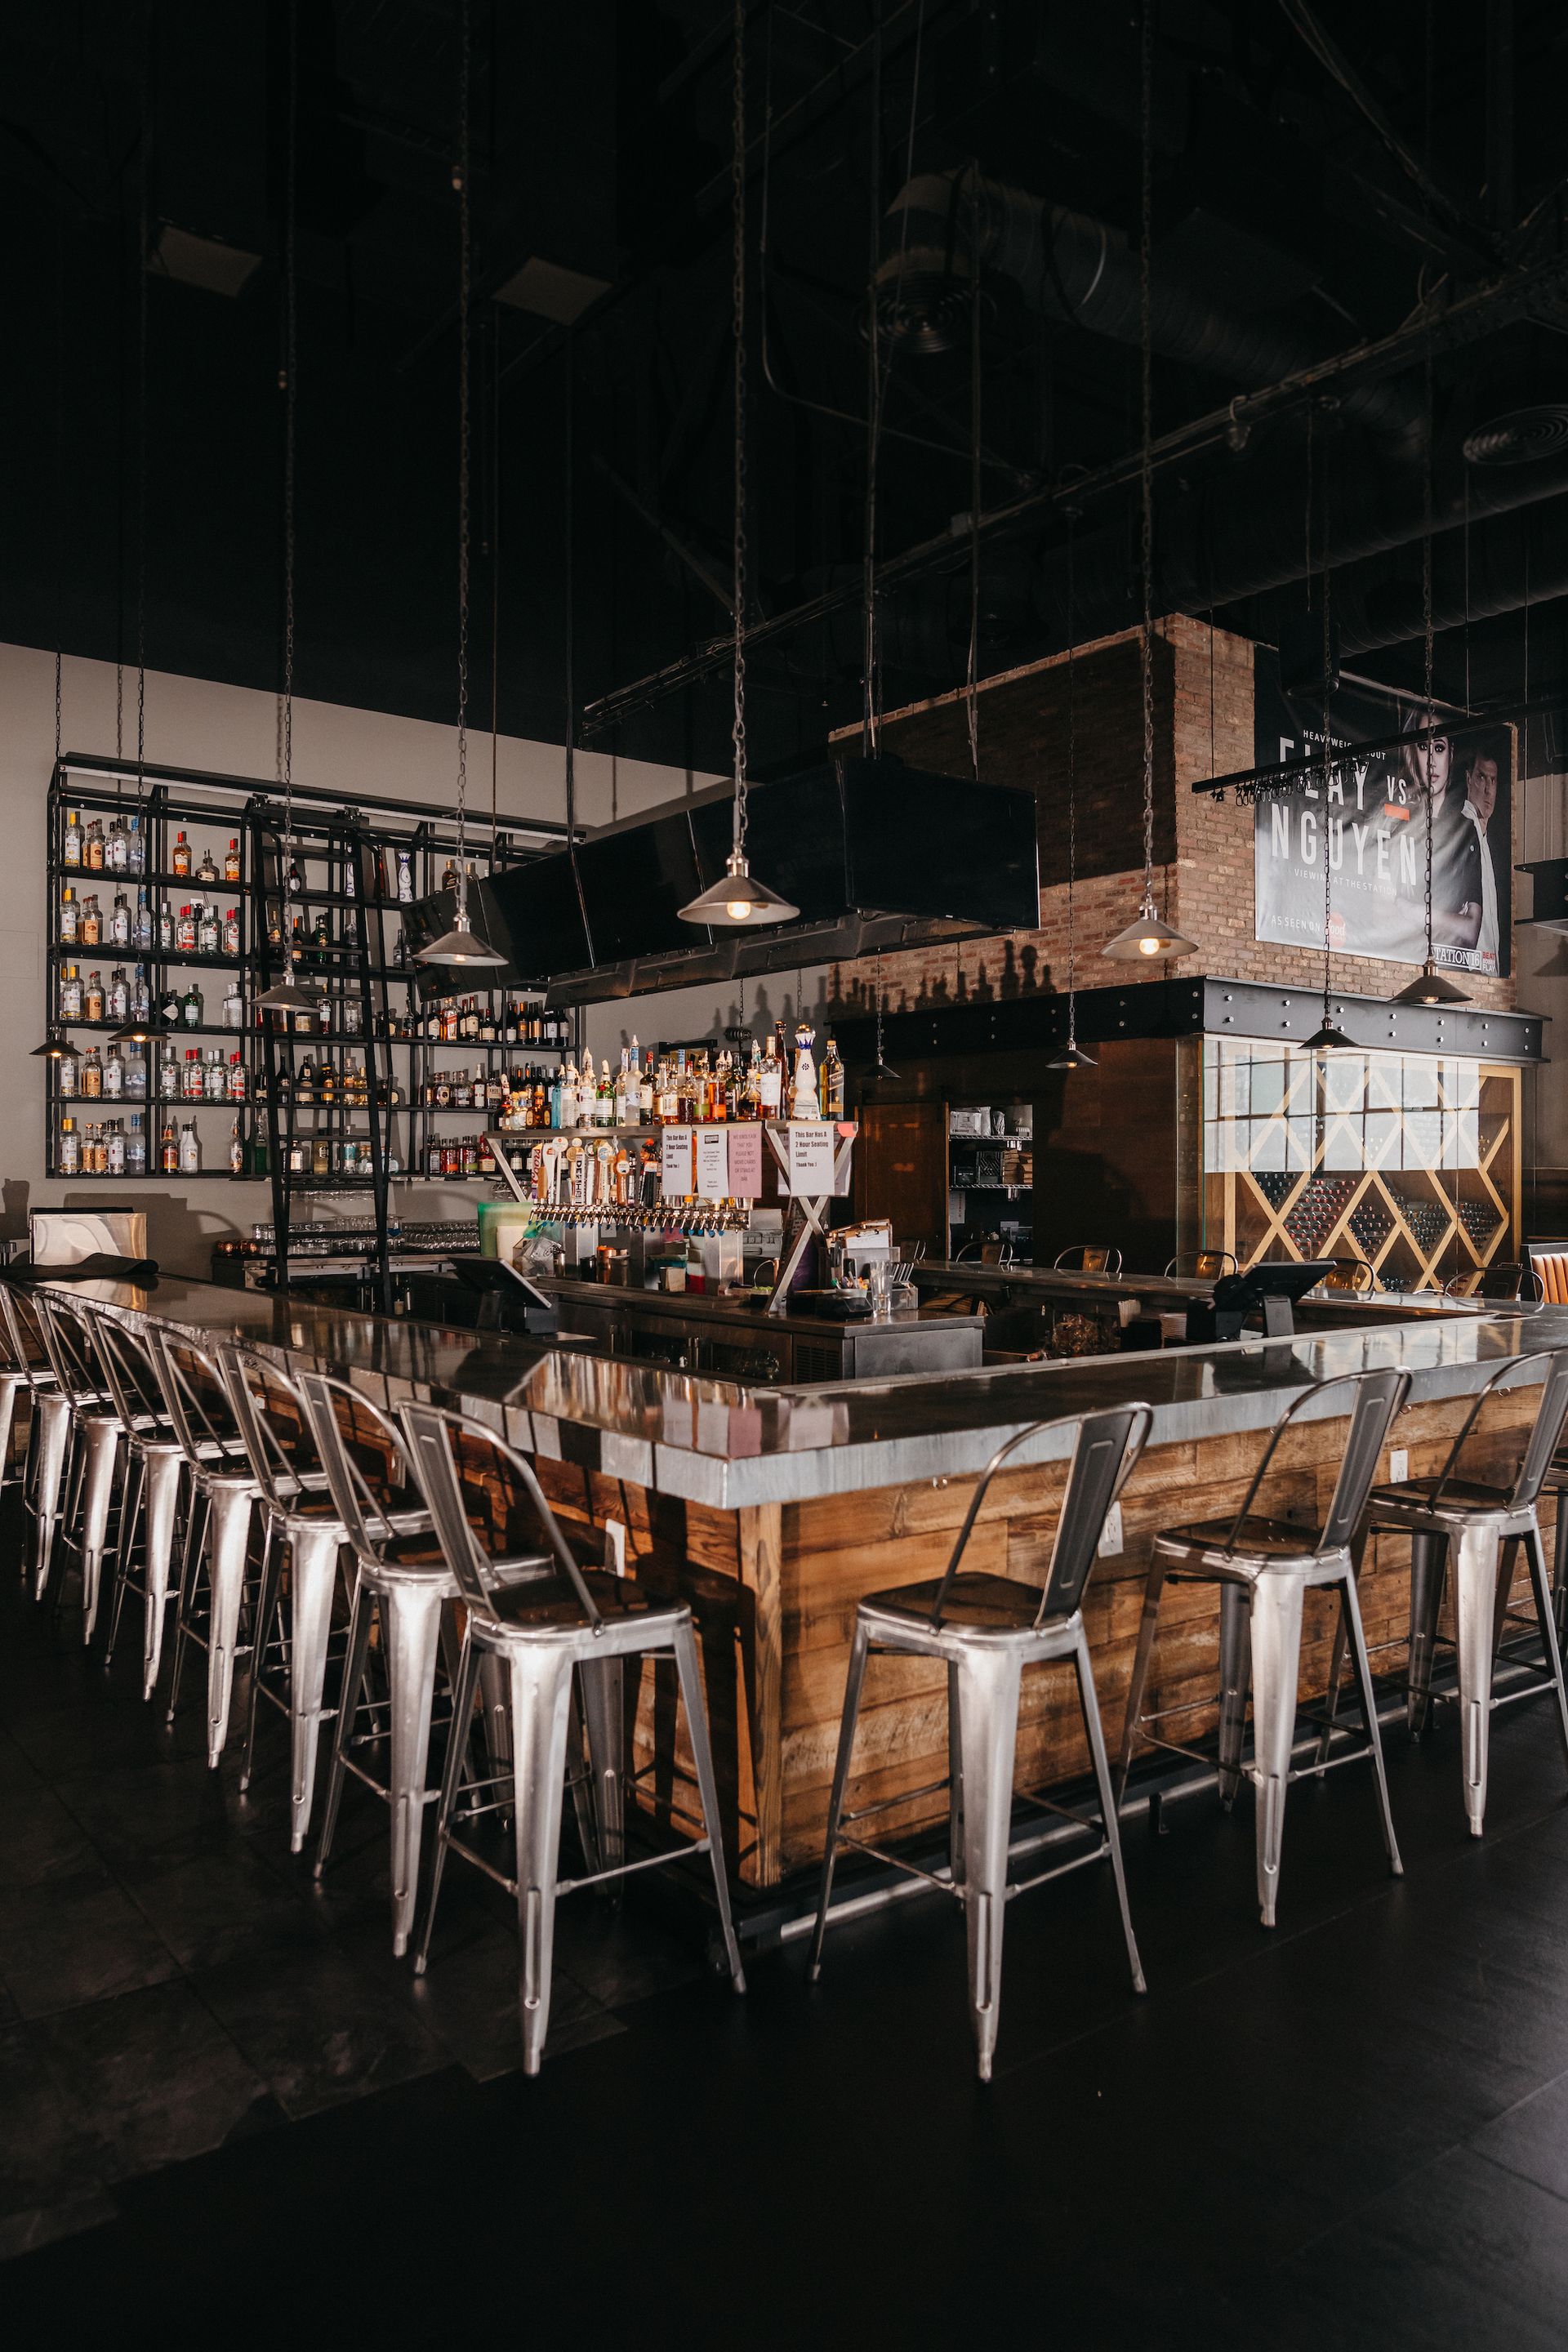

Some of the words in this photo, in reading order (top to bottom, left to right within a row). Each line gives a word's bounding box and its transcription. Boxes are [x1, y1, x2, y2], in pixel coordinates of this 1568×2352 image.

[1303, 729, 1352, 749] HEAVYWEI
[1367, 751, 1386, 760] OUT
[1387, 775, 1406, 805] VS
[1272, 803, 1416, 886] NGUYEN
[1333, 876, 1343, 886] AT
[1344, 878, 1361, 889] THE
[1363, 882, 1397, 897] STATION
[1271, 915, 1282, 927] AS
[1284, 916, 1307, 931] SEEN
[1308, 920, 1321, 932] ON
[1432, 947, 1469, 966] TATION
[1472, 951, 1480, 967] 16
